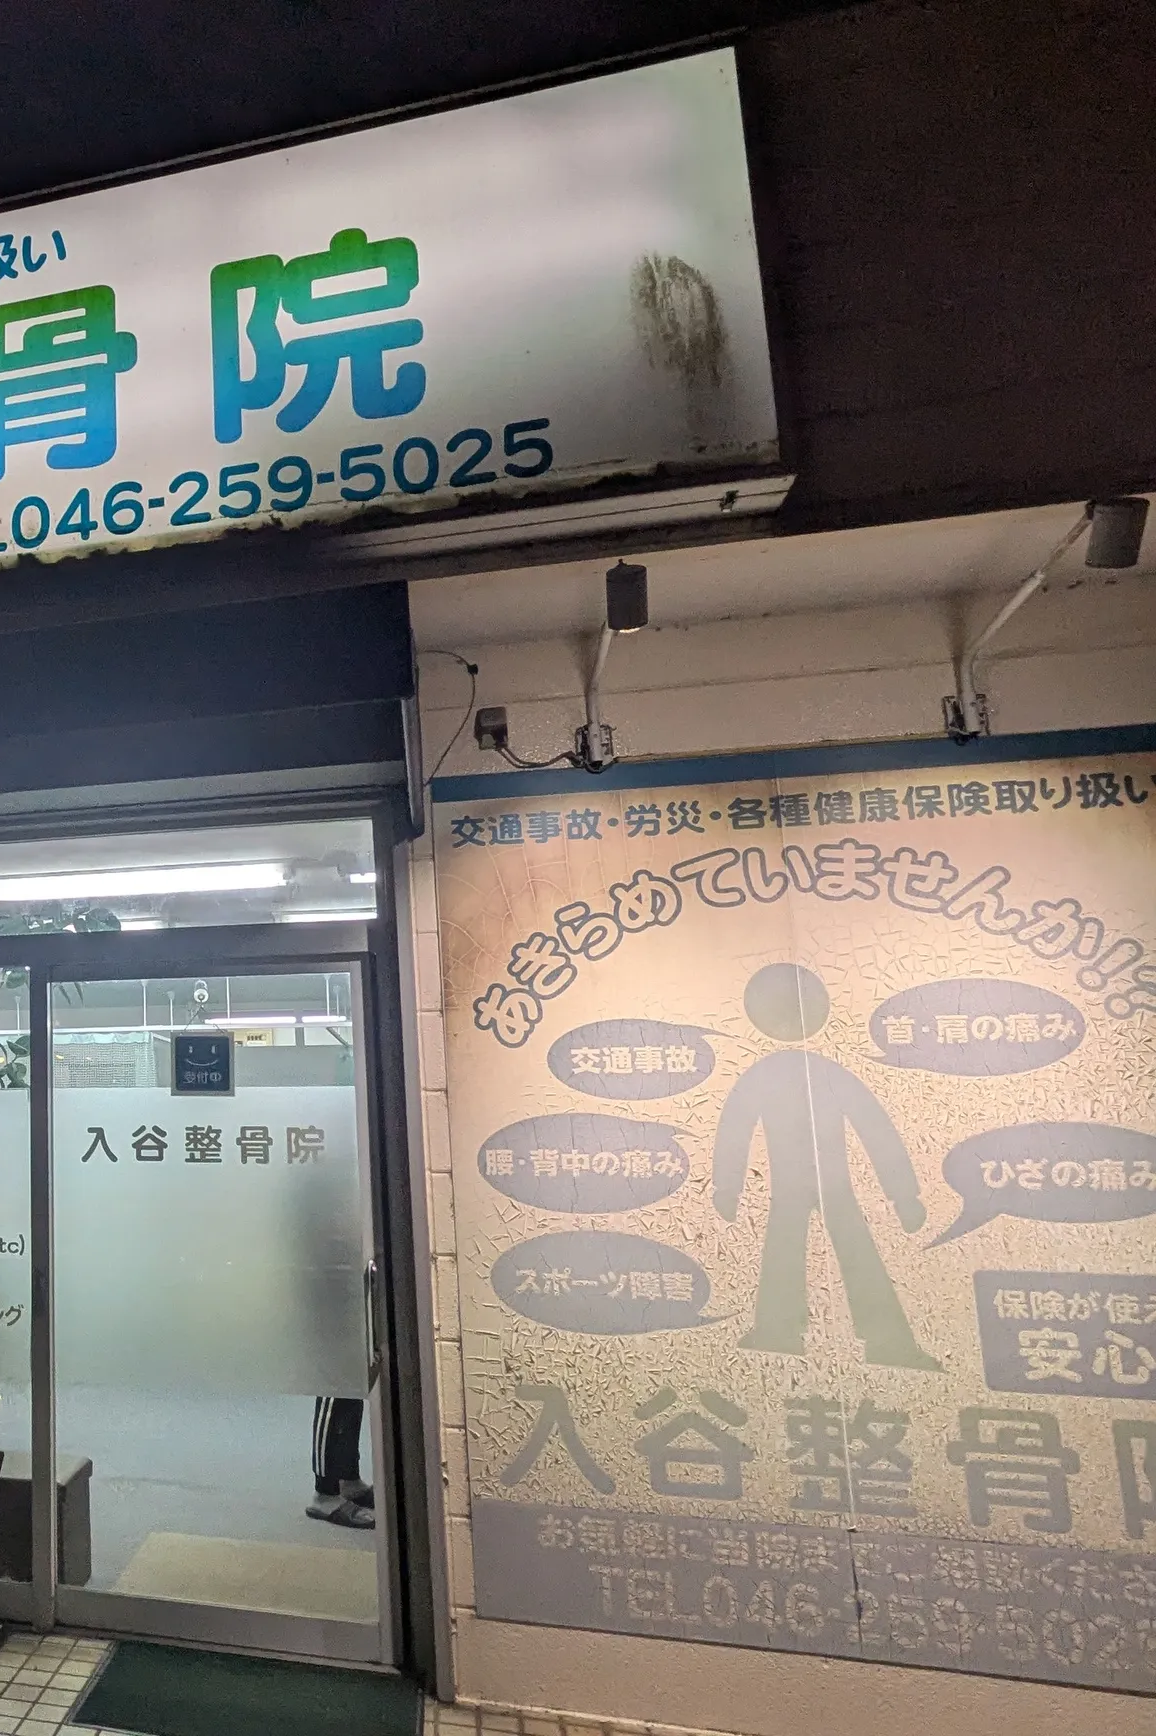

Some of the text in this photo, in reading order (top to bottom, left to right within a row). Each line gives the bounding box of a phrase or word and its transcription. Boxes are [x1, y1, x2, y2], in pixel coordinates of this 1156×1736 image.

[882, 1012, 1077, 1044] 首・肩の痛み
[570, 1045, 698, 1075] 交通事故
[81, 1124, 325, 1165] 入谷整骨院
[485, 1148, 684, 1179] 腰・背中の痛み
[980, 1157, 1156, 1192] ひざの痛み
[515, 1266, 694, 1301] スポーツ障害
[1019, 1327, 1156, 1385] 安心
